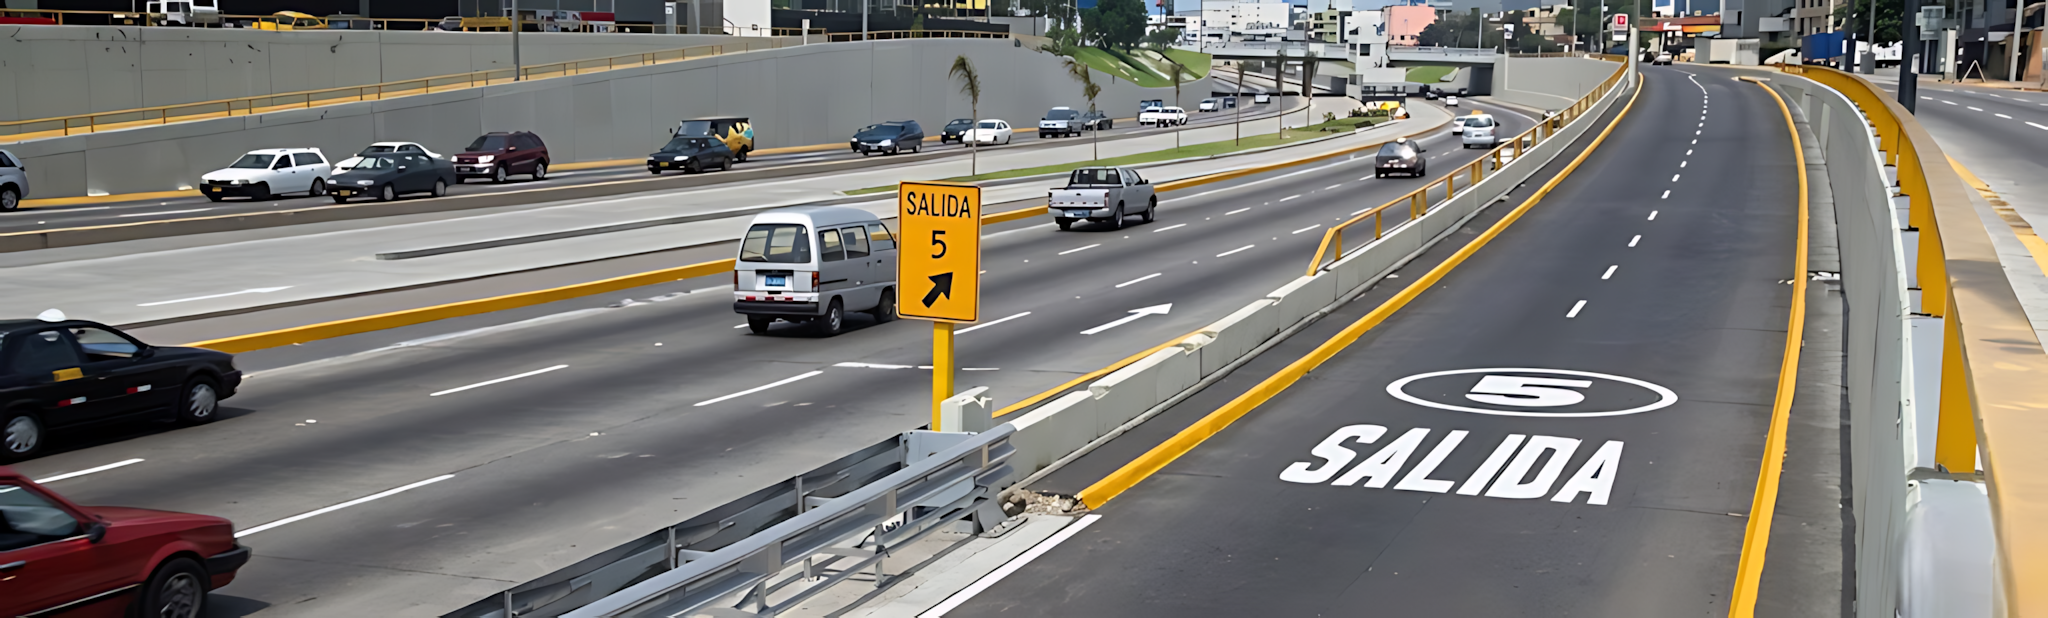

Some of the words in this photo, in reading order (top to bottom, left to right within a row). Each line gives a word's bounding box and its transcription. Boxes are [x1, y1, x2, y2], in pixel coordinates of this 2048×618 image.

[906, 191, 971, 218] SALIDA
[931, 230, 947, 259] 5
[1465, 375, 1593, 407] 5
[1279, 424, 1624, 505] SALIDA
